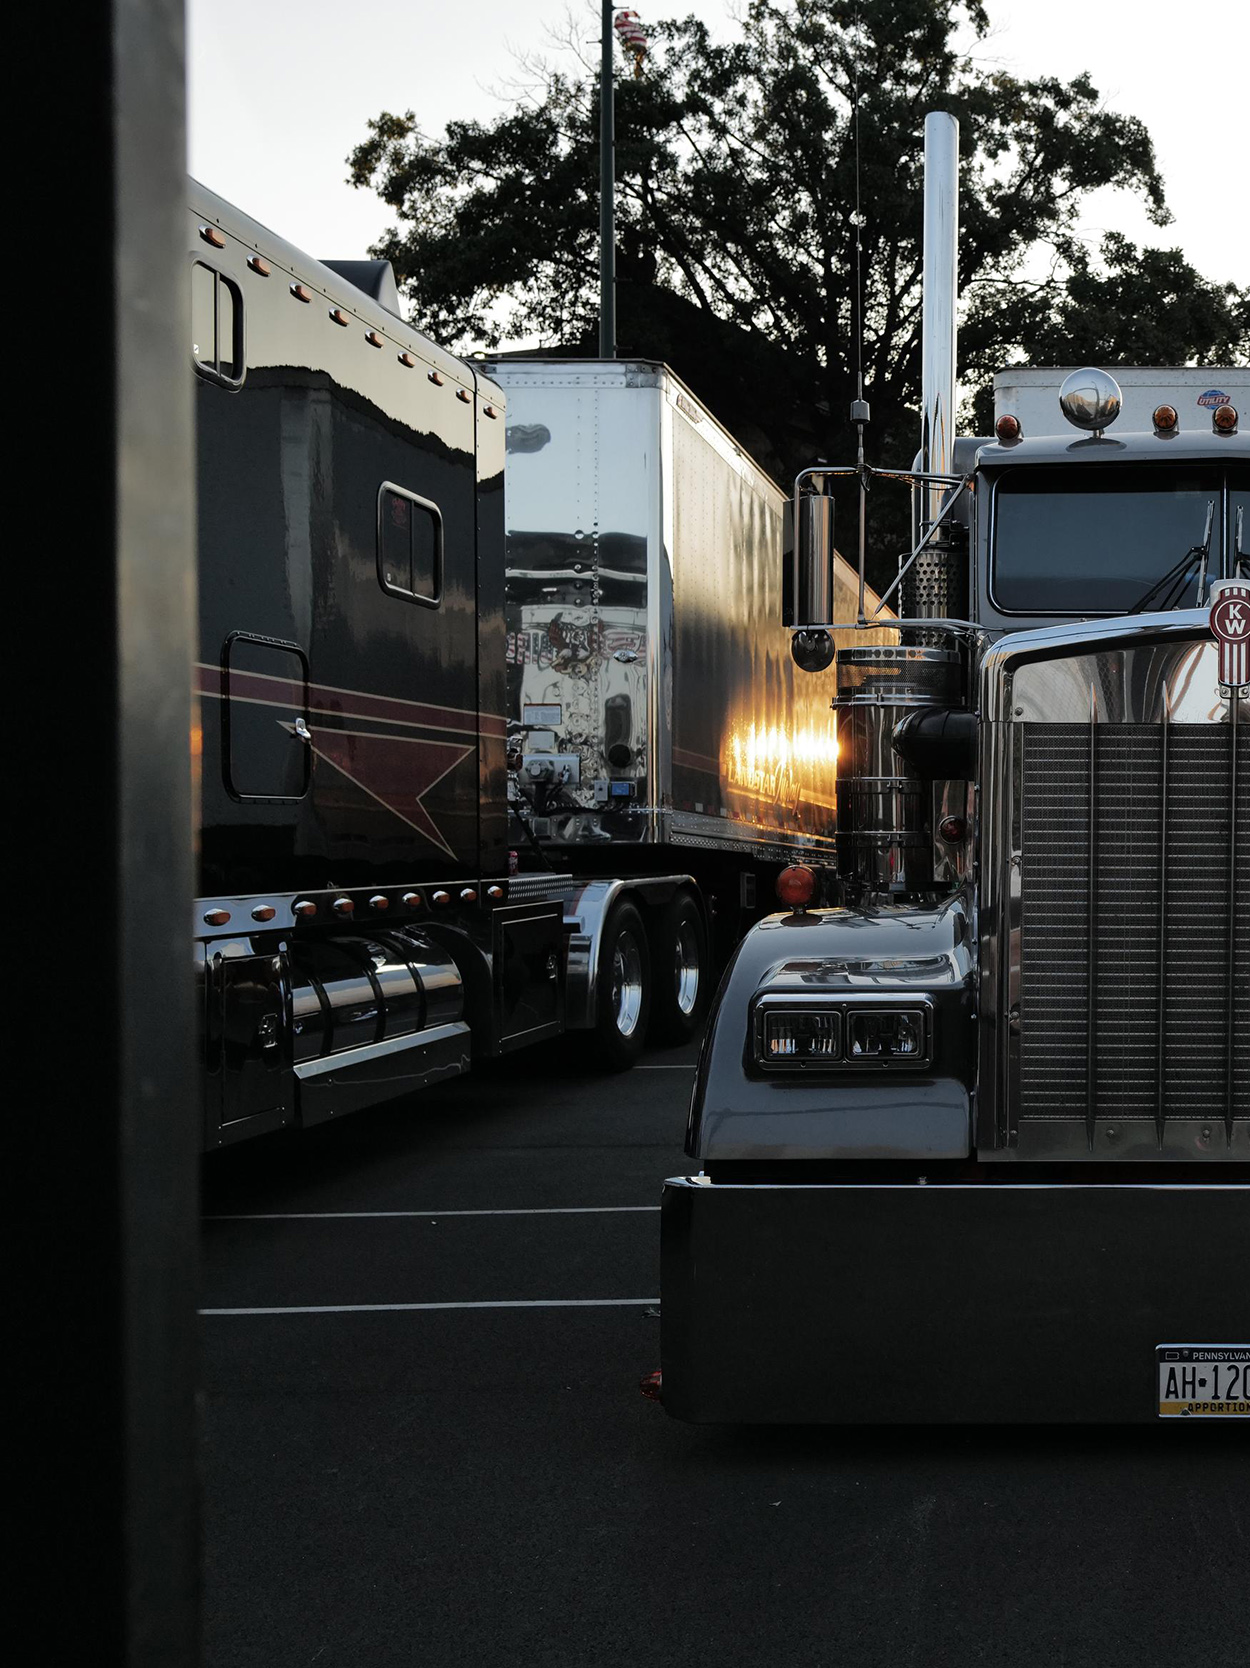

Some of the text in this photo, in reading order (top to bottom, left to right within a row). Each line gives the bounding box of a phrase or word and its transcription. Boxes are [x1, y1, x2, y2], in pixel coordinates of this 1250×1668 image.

[1199, 396, 1229, 405] UTILITY
[1229, 604, 1242, 619] K
[1225, 619, 1246, 634] W
